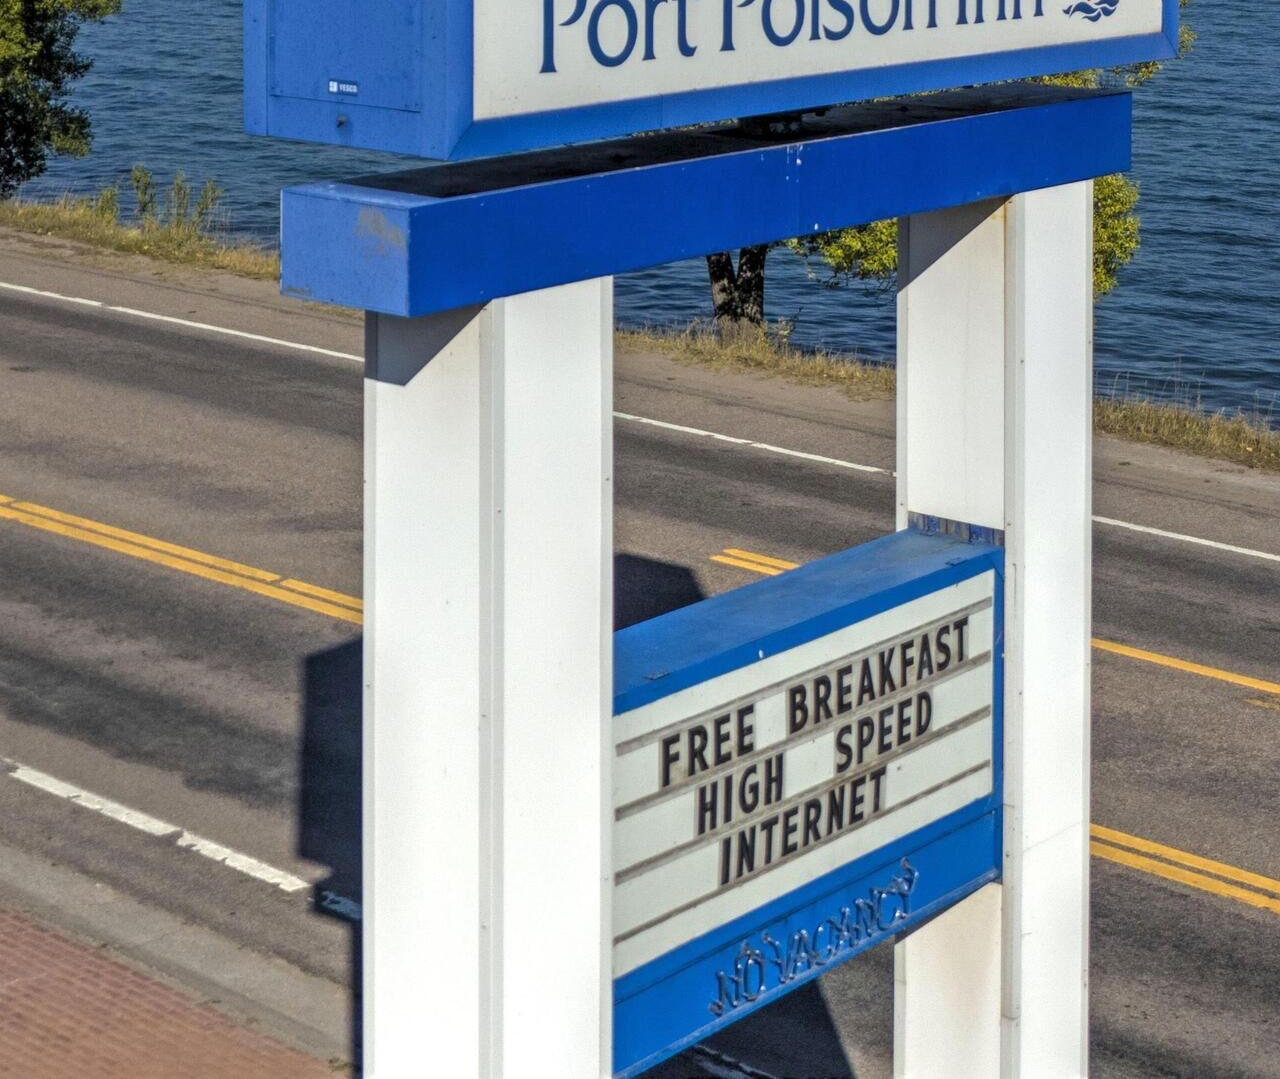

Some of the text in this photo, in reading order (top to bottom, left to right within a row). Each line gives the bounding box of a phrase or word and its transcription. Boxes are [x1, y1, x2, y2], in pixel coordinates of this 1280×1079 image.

[661, 617, 969, 788] FREE BREAKFAST
[696, 691, 933, 835] HIGH SPEED
[721, 767, 887, 886] INTERNET
[710, 856, 919, 1015] NO VACANCY
